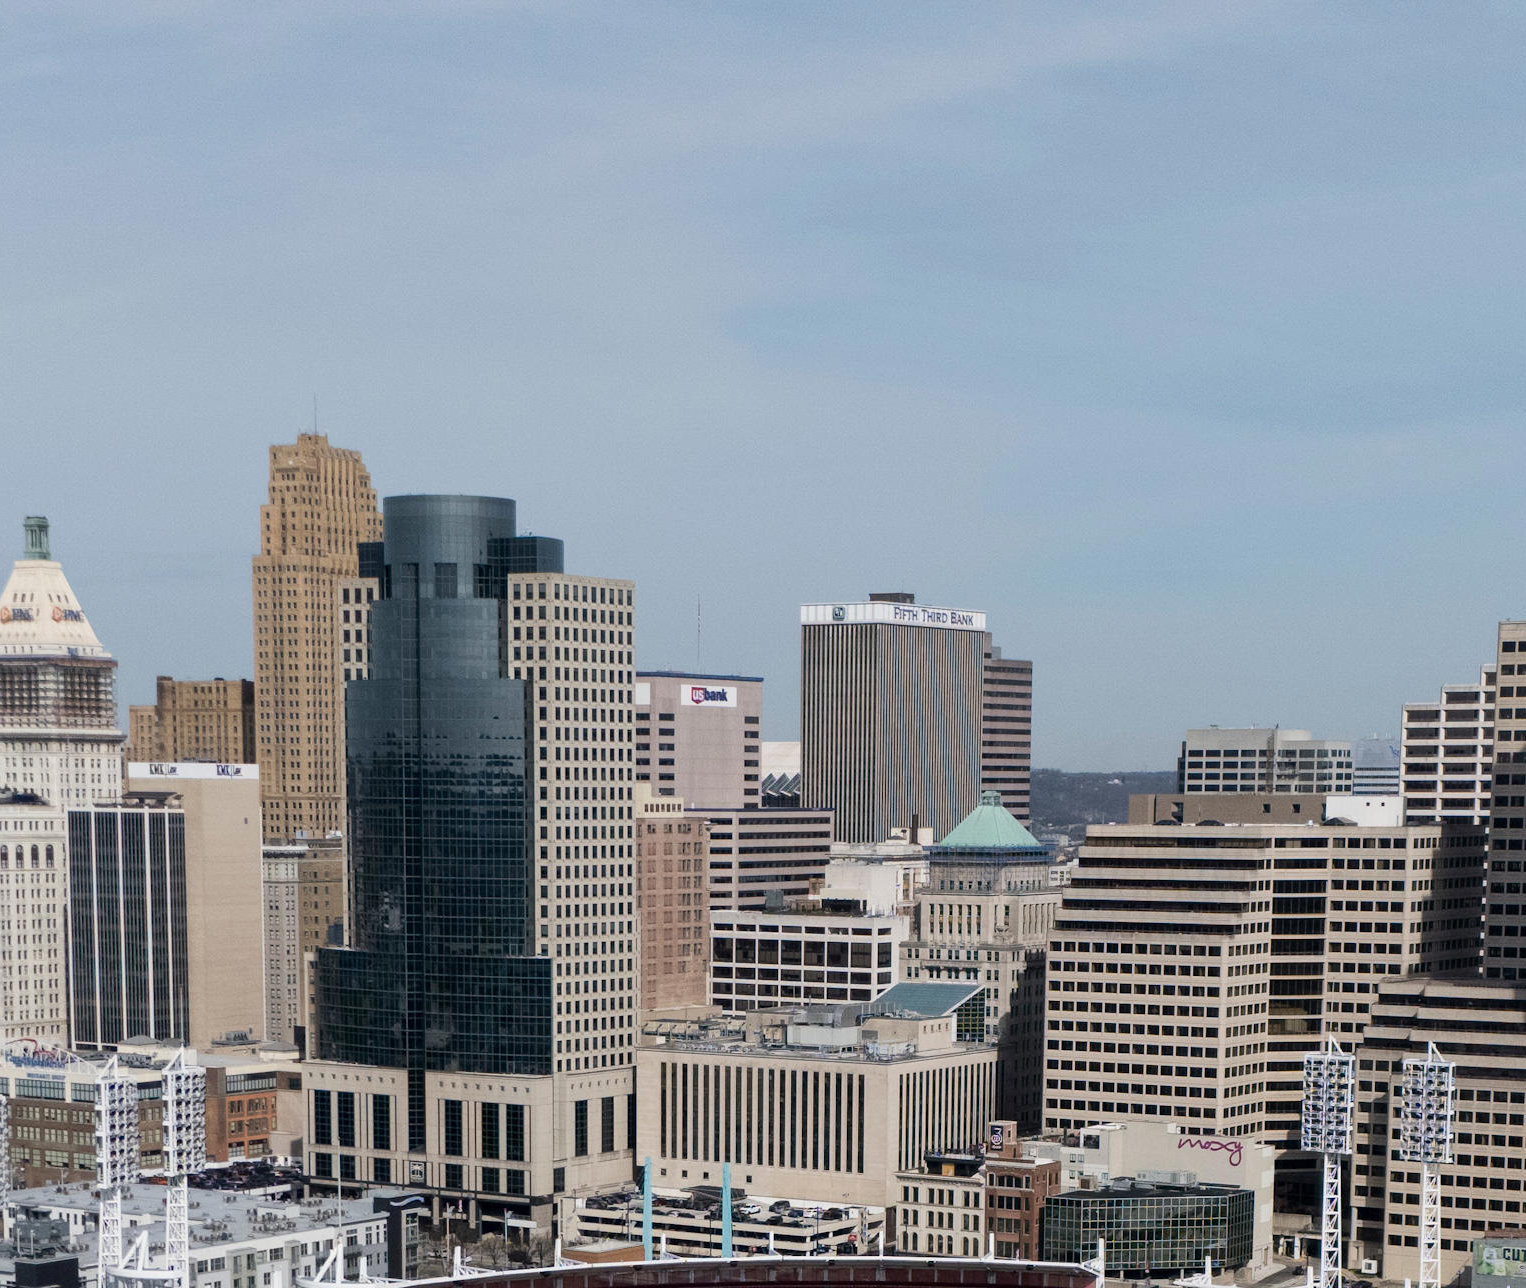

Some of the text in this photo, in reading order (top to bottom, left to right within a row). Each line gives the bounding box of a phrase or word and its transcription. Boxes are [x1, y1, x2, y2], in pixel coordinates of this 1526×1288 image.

[894, 606, 974, 626] FIFTH THIRD BANK
[1178, 1138, 1244, 1167] moxy
